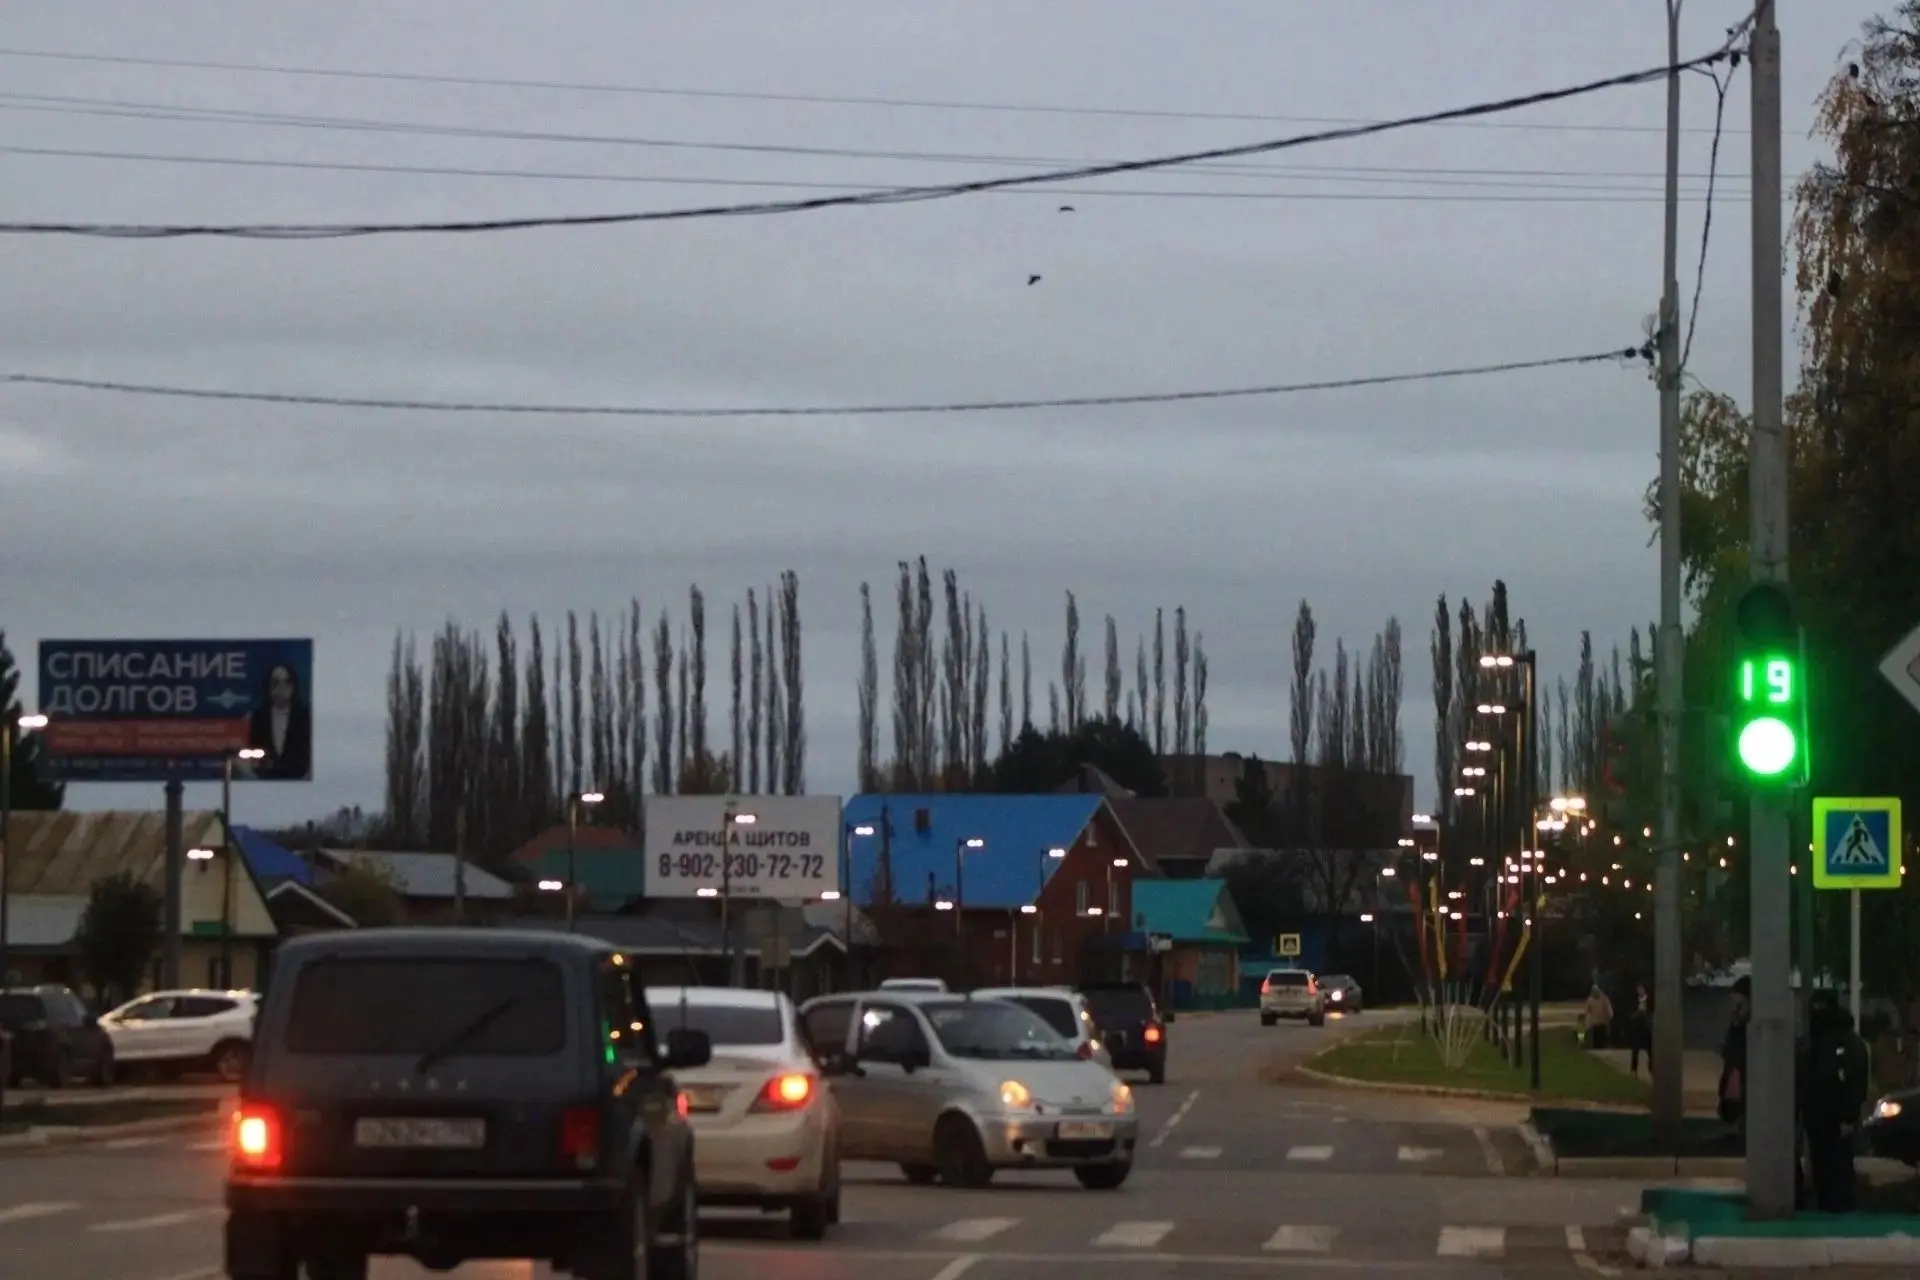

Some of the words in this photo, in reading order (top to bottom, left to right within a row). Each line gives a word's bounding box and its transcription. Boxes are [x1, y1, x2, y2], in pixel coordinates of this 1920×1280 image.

[48, 652, 248, 679] СПИСАНИЕ
[1743, 660, 1791, 703] 19
[48, 685, 198, 715] ДОЛГОВ
[672, 830, 741, 847] АРЕНДА
[745, 831, 811, 848] ЩИТОВ
[658, 853, 824, 879] 8-902-230-72-72
